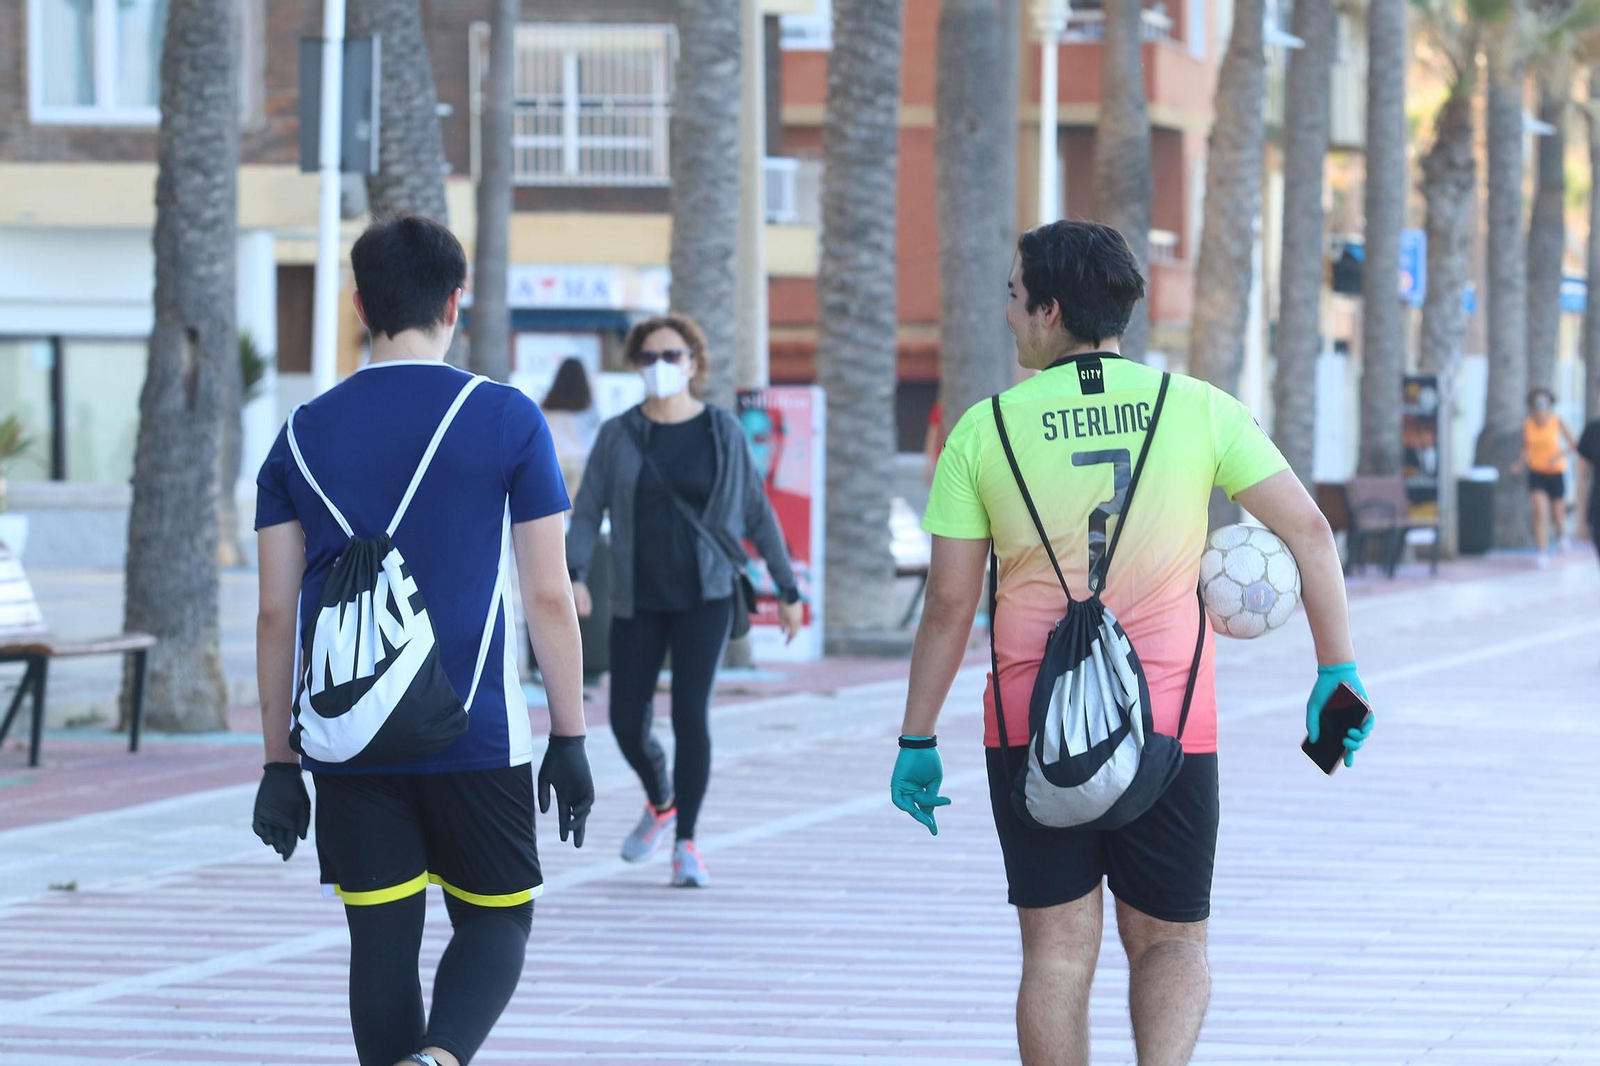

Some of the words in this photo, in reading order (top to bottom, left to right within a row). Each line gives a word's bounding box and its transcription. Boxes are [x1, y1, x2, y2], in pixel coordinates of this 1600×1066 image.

[1080, 368, 1102, 381] CITY
[1042, 402, 1152, 441] STERLING
[1071, 448, 1132, 592] 7
[311, 547, 432, 697] NIKE
